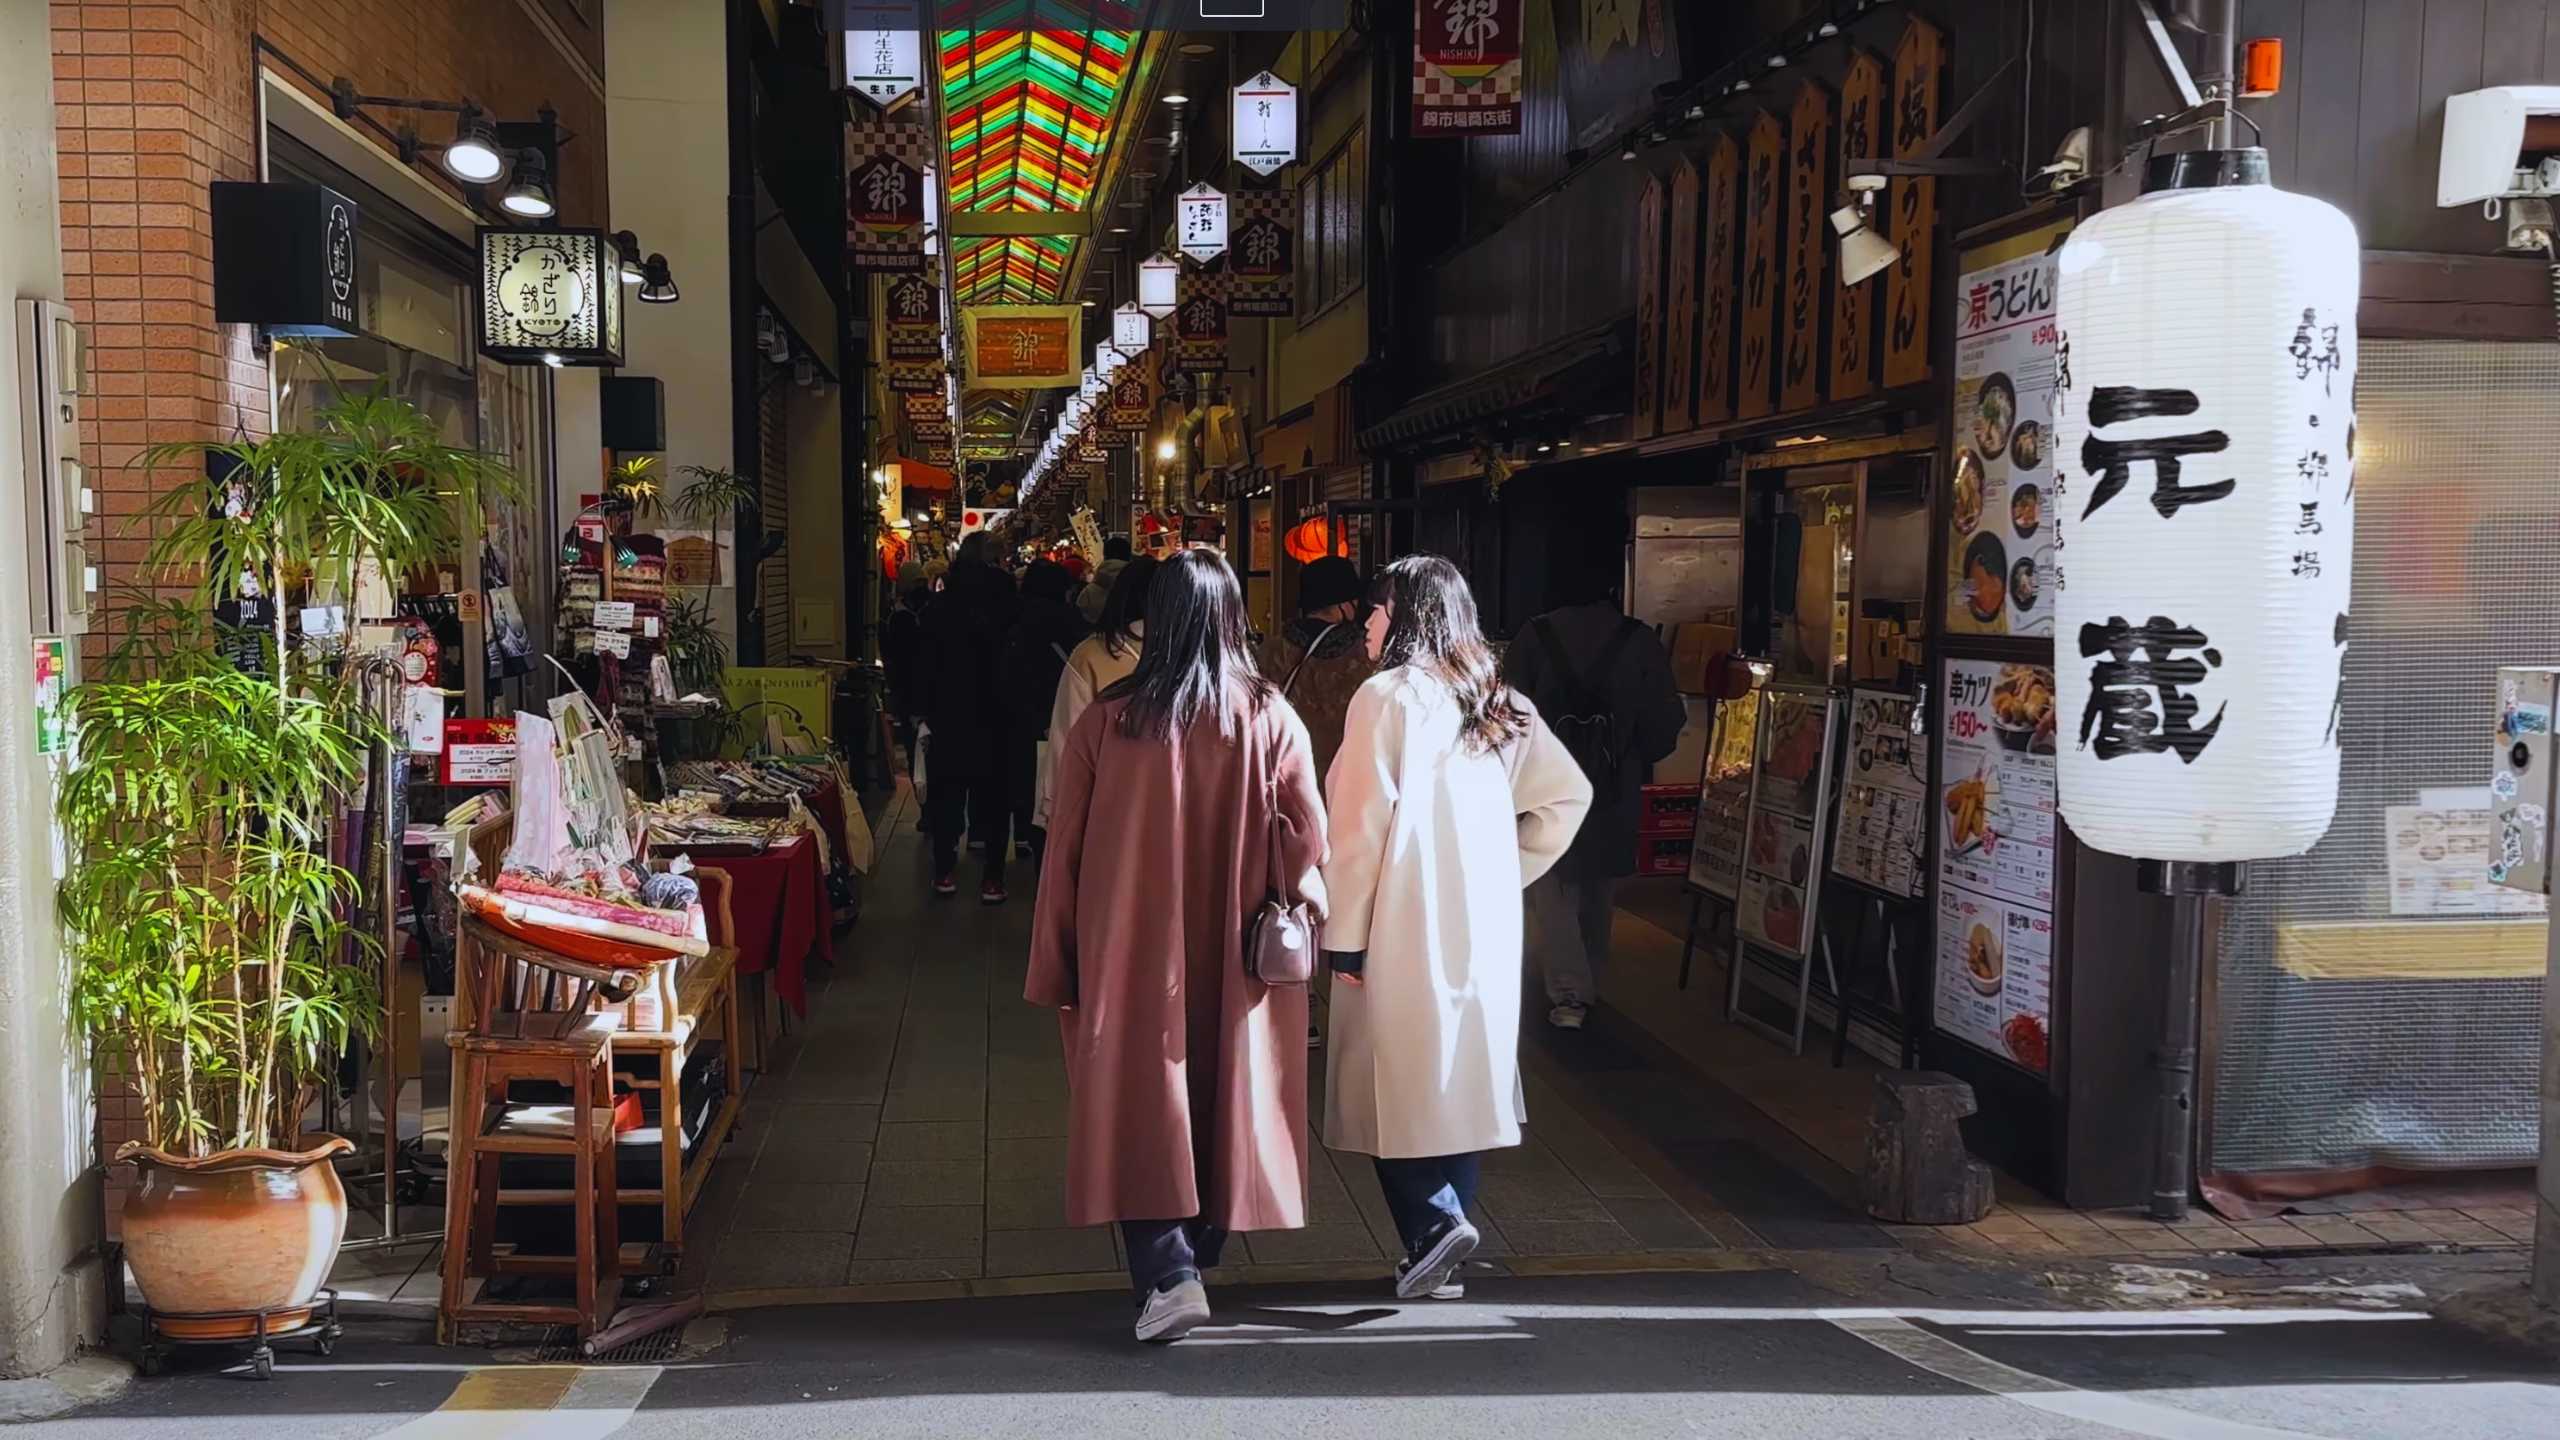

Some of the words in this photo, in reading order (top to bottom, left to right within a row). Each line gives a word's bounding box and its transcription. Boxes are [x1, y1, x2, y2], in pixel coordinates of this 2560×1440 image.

[1440, 48, 1477, 60] NISHIKI
[870, 85, 896, 95] 生花
[1422, 109, 1512, 127] 錦市場商店街
[859, 161, 907, 222] 錦
[1239, 222, 1281, 273] 錦
[541, 253, 562, 316] かざり
[894, 281, 929, 321] 錦
[1968, 268, 2052, 330] 京うどん
[1184, 298, 1217, 341] 錦
[1008, 327, 1038, 369] 錦
[2076, 385, 2236, 765] 元蔵
[239, 599, 258, 619] 2024
[1950, 670, 1992, 707] 串カツ
